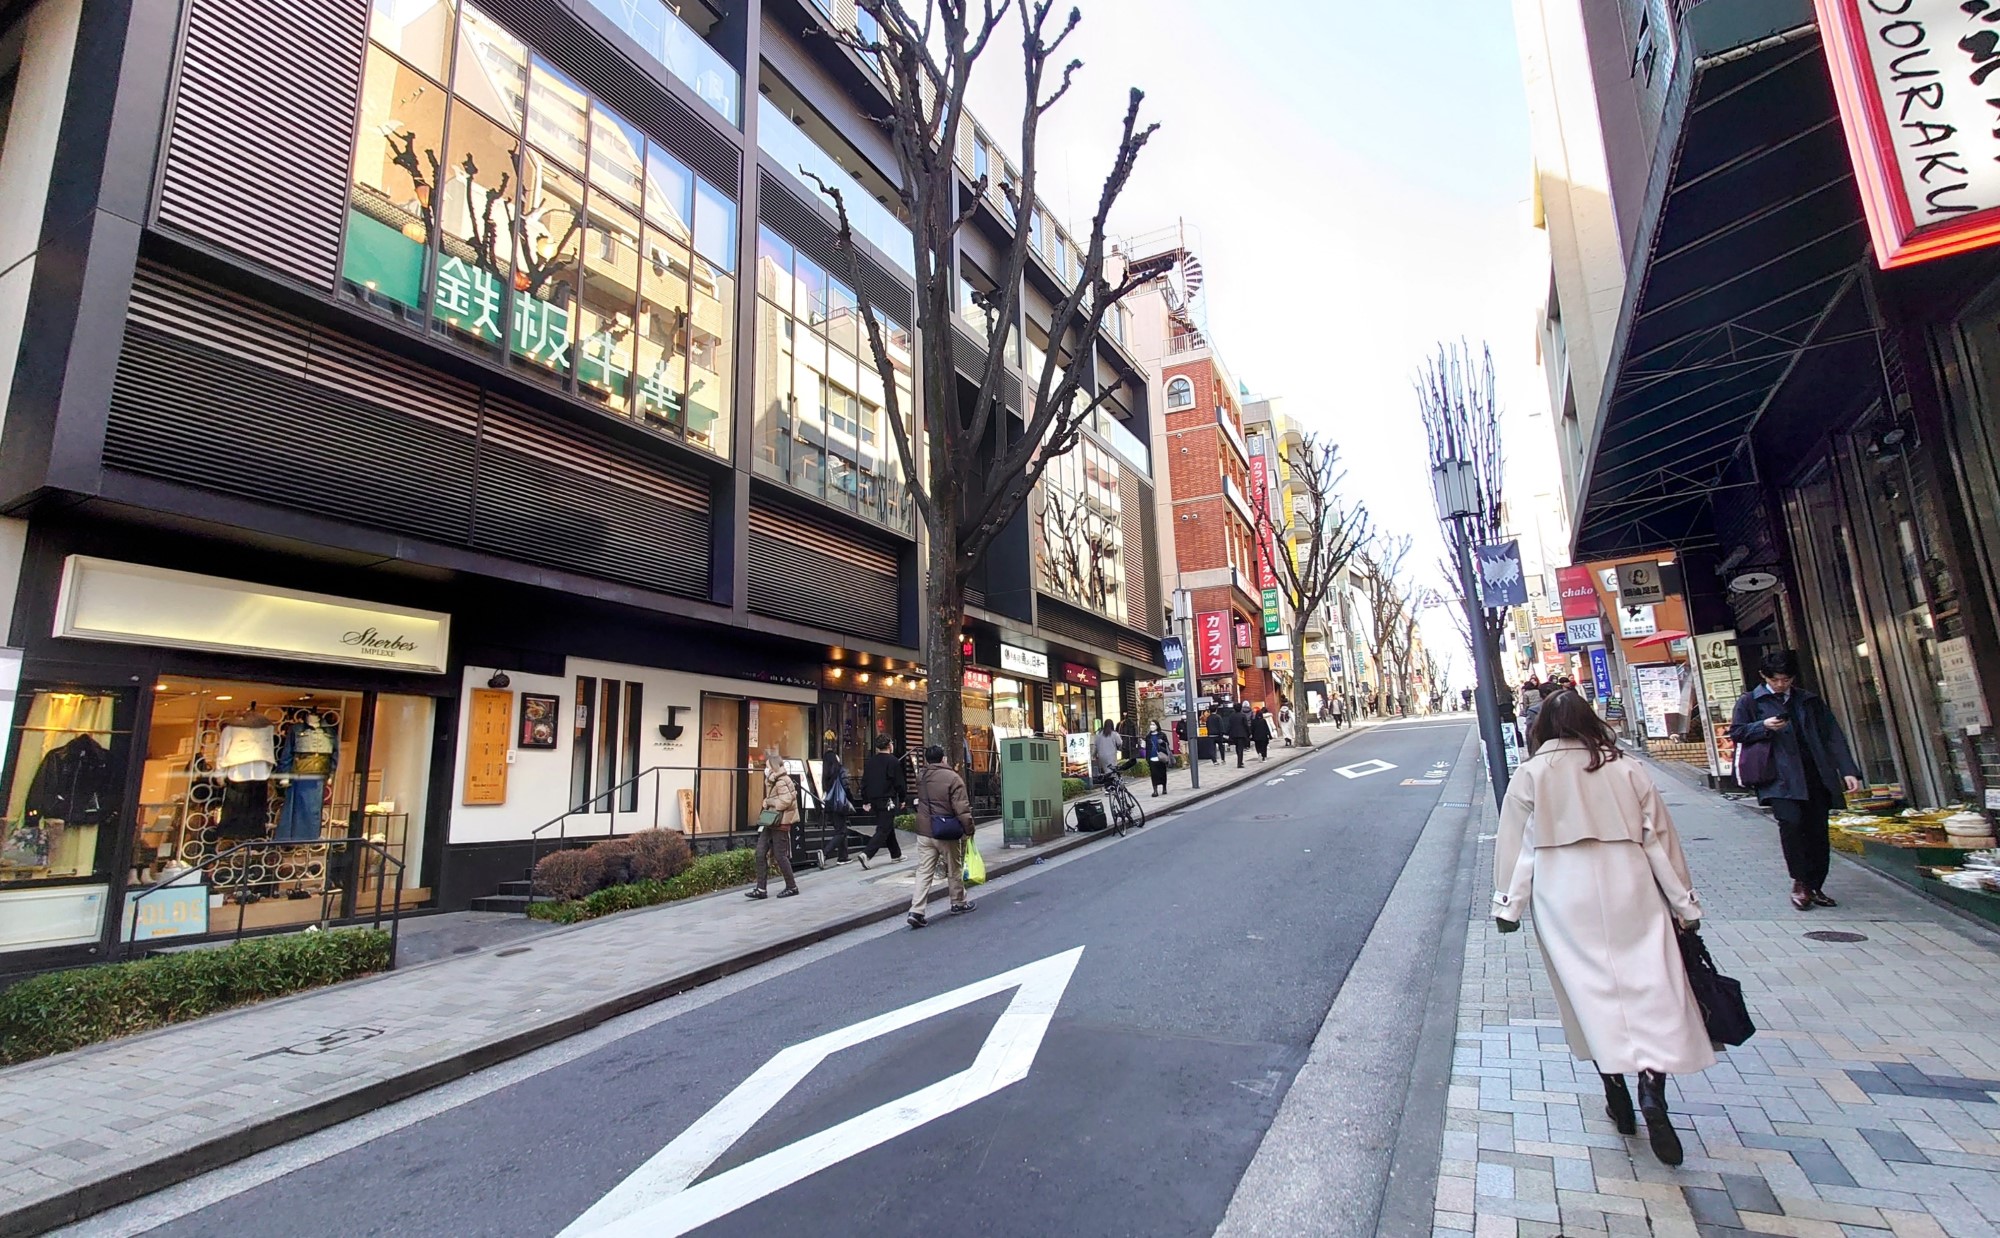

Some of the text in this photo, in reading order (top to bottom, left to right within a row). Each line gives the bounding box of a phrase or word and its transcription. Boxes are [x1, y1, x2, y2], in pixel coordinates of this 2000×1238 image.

[1562, 587, 1594, 598] chako
[1239, 624, 1248, 647] カラオケ
[1568, 622, 1598, 634] SHOT
[1573, 631, 1597, 641] BAR
[339, 627, 418, 652] Sherbes
[1207, 615, 1223, 671] カラオケ
[361, 647, 396, 658] IMPLEXE
[1594, 656, 1607, 690] たんす屋
